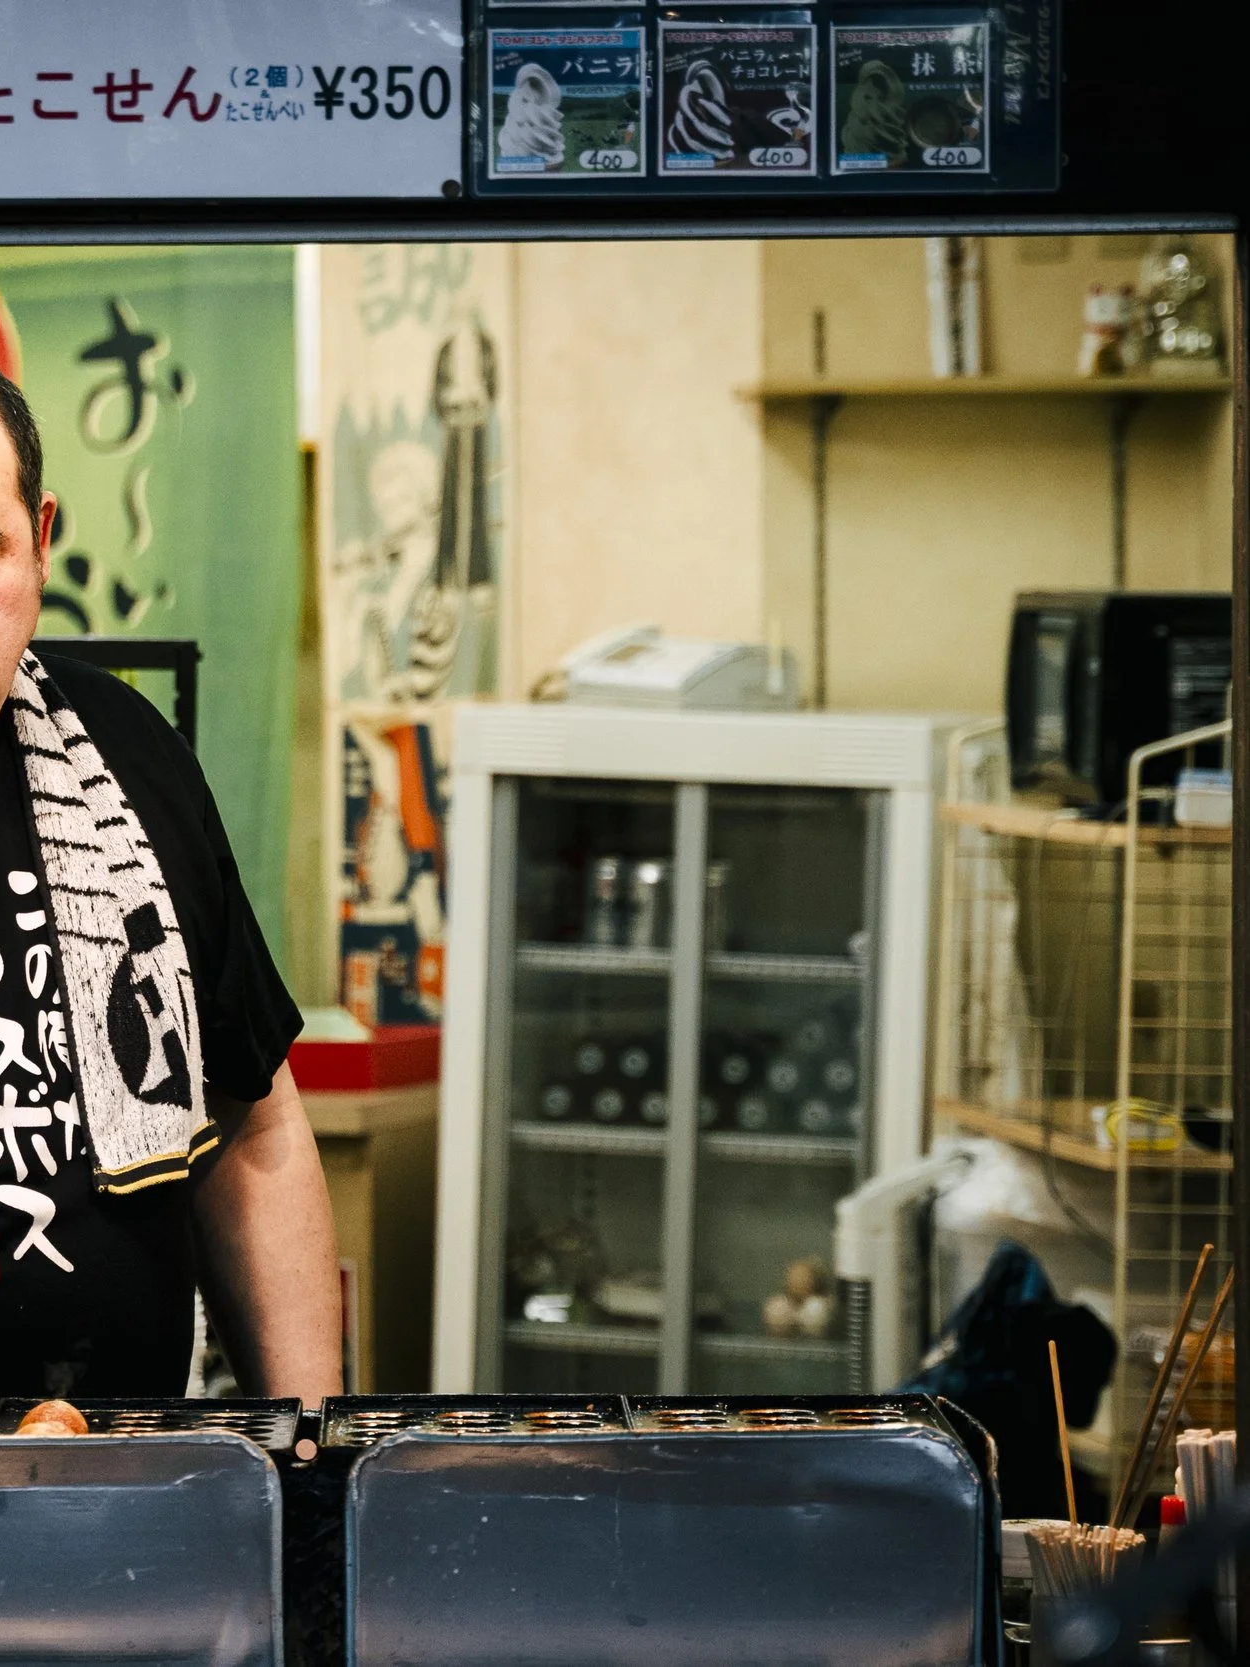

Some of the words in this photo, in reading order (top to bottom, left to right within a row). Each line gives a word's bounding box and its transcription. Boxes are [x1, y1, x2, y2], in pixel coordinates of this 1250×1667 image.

[561, 55, 634, 78] バニラ
[312, 66, 451, 120] ¥350
[587, 150, 623, 171] 400
[756, 148, 794, 167] 400
[930, 147, 968, 165] 400
